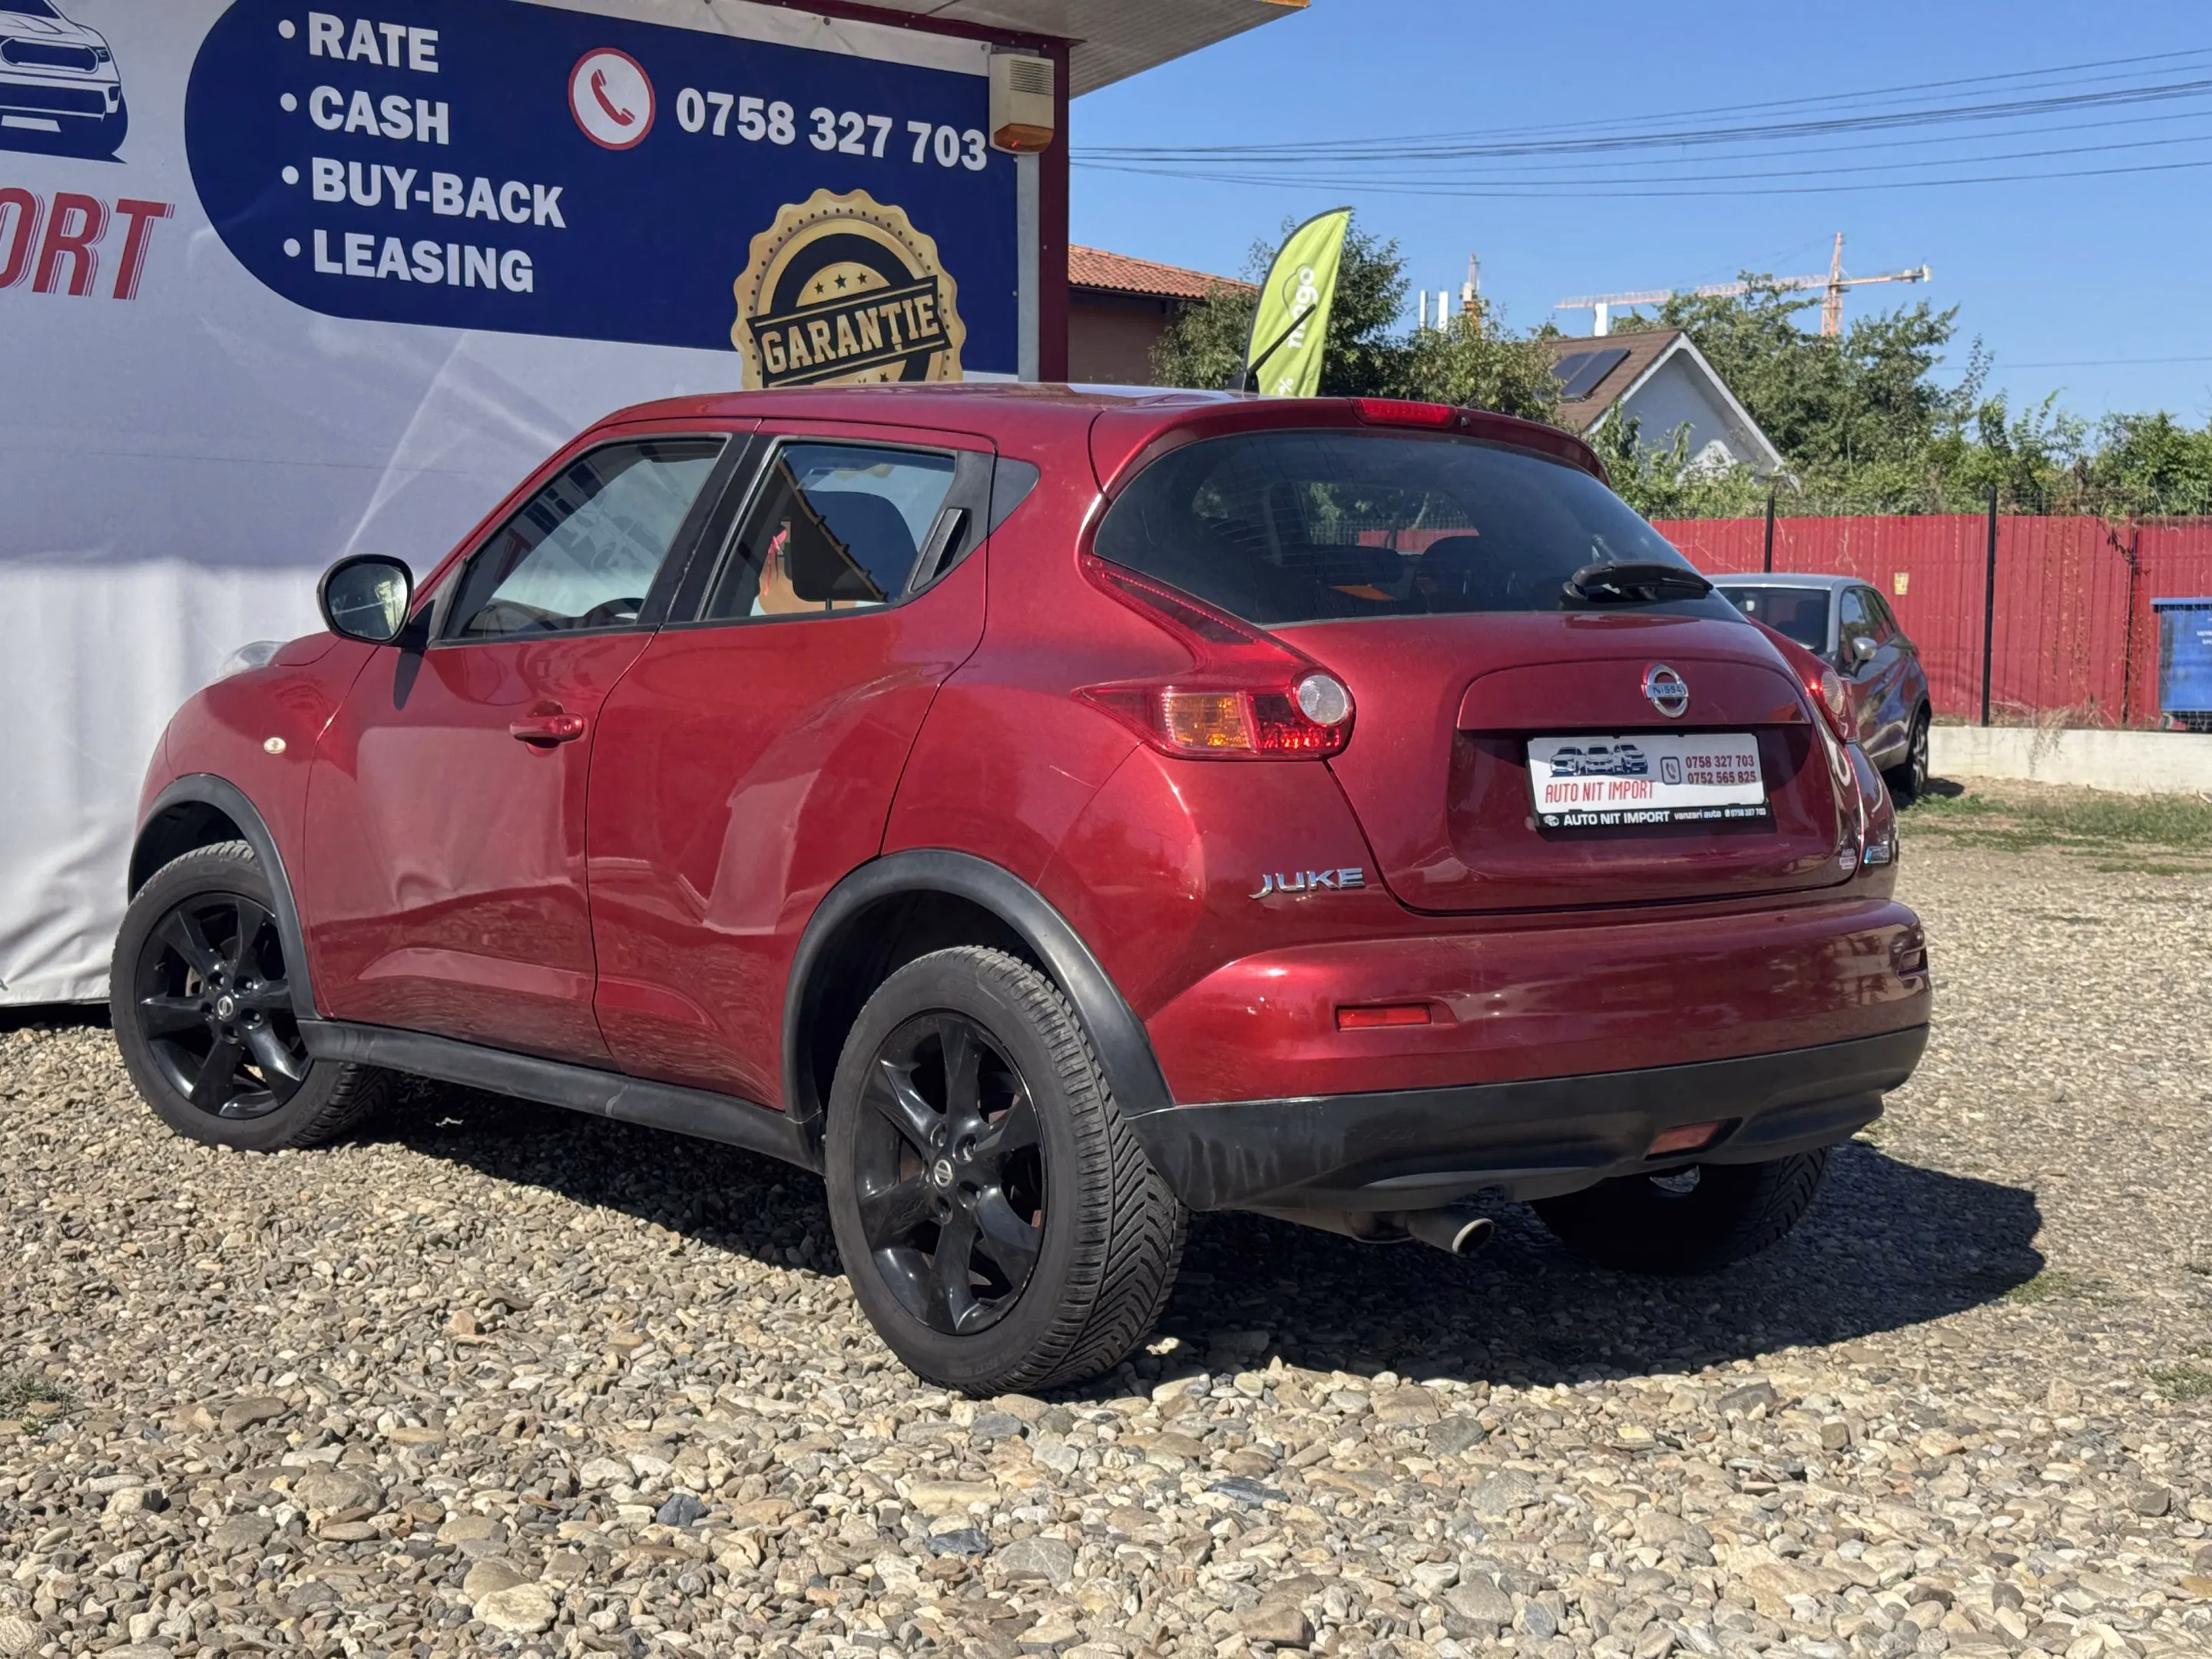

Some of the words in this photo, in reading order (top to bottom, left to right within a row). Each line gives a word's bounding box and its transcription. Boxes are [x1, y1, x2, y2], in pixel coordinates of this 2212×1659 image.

[309, 12, 439, 73] RATE
[309, 85, 449, 145] CASH
[676, 88, 796, 145] 0758
[808, 107, 892, 158] 327
[907, 120, 987, 171] 703
[312, 157, 567, 228] BUY-BACK
[313, 229, 534, 293] LEASING
[1685, 756, 1712, 768] 0758
[1714, 755, 1733, 767] 327
[1735, 755, 1754, 767] 703
[1687, 772, 1714, 784] 0752
[1716, 771, 1735, 783] 565
[1737, 770, 1757, 783] 825
[1545, 783, 1578, 803] AUTO
[1582, 782, 1604, 801] NIT
[1608, 780, 1654, 800] IMPORT
[1564, 814, 1598, 826] AUTO
[1600, 813, 1623, 824] NIT
[1624, 811, 1671, 823] IMPORT
[1704, 810, 1722, 819] auto
[1248, 868, 1365, 899] JUKE
